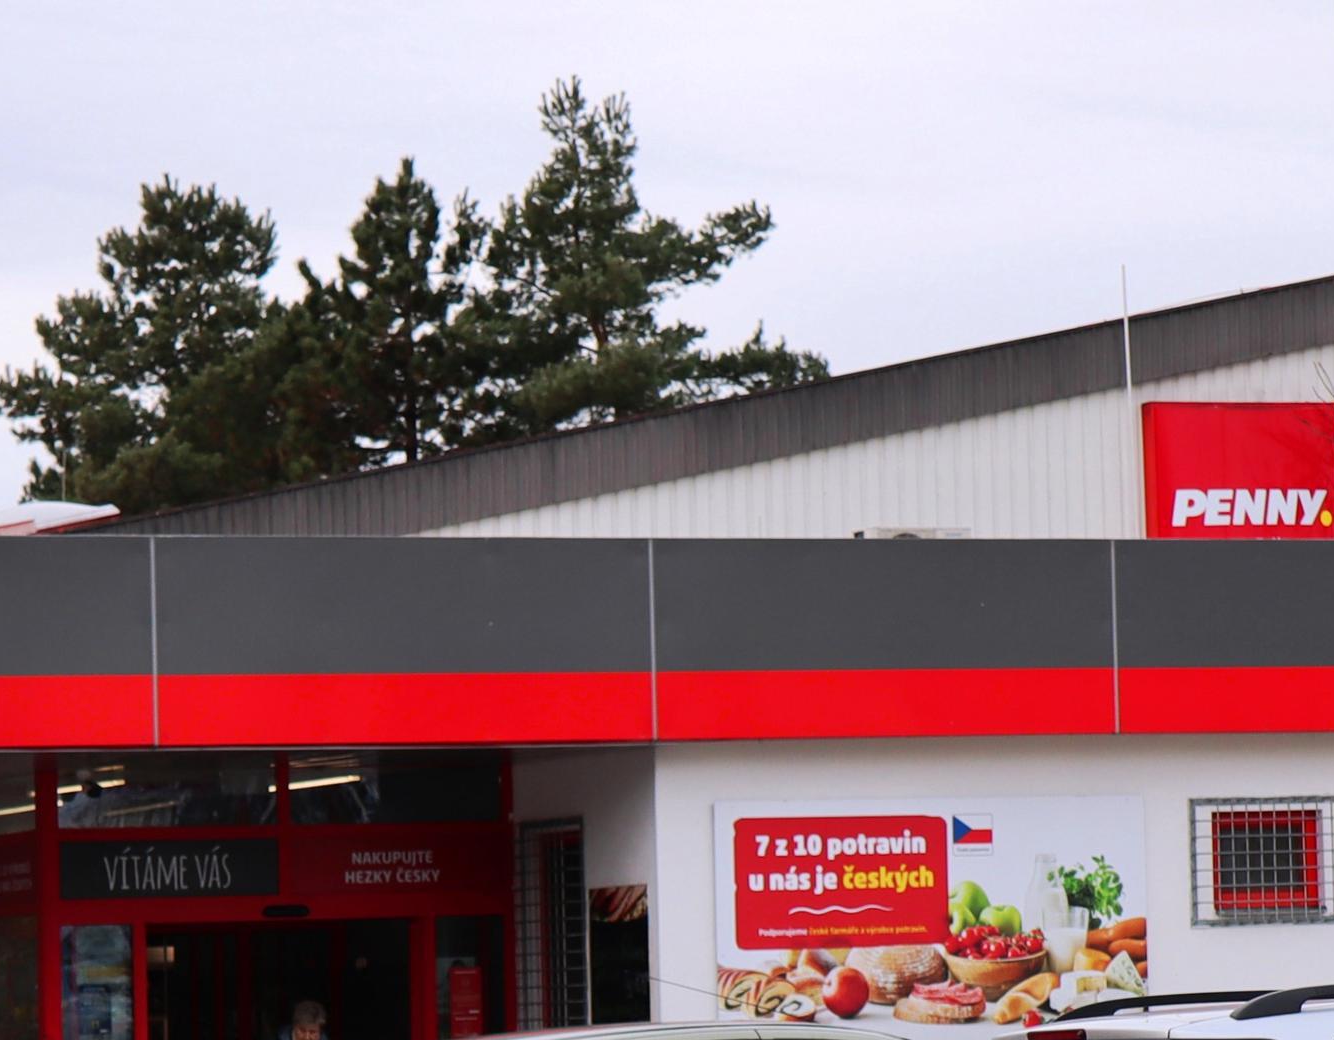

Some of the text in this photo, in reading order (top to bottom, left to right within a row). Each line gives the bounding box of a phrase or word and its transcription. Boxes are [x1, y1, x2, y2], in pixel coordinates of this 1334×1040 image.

[1172, 489, 1333, 527] PENNY.
[351, 850, 433, 867] NAKUPUJTE
[755, 828, 927, 861] 7 z 10 potravin
[104, 845, 232, 890] VÍTÁME VÁS
[345, 864, 440, 885] HEZKY ČESKY
[748, 863, 935, 896] u nás je českých
